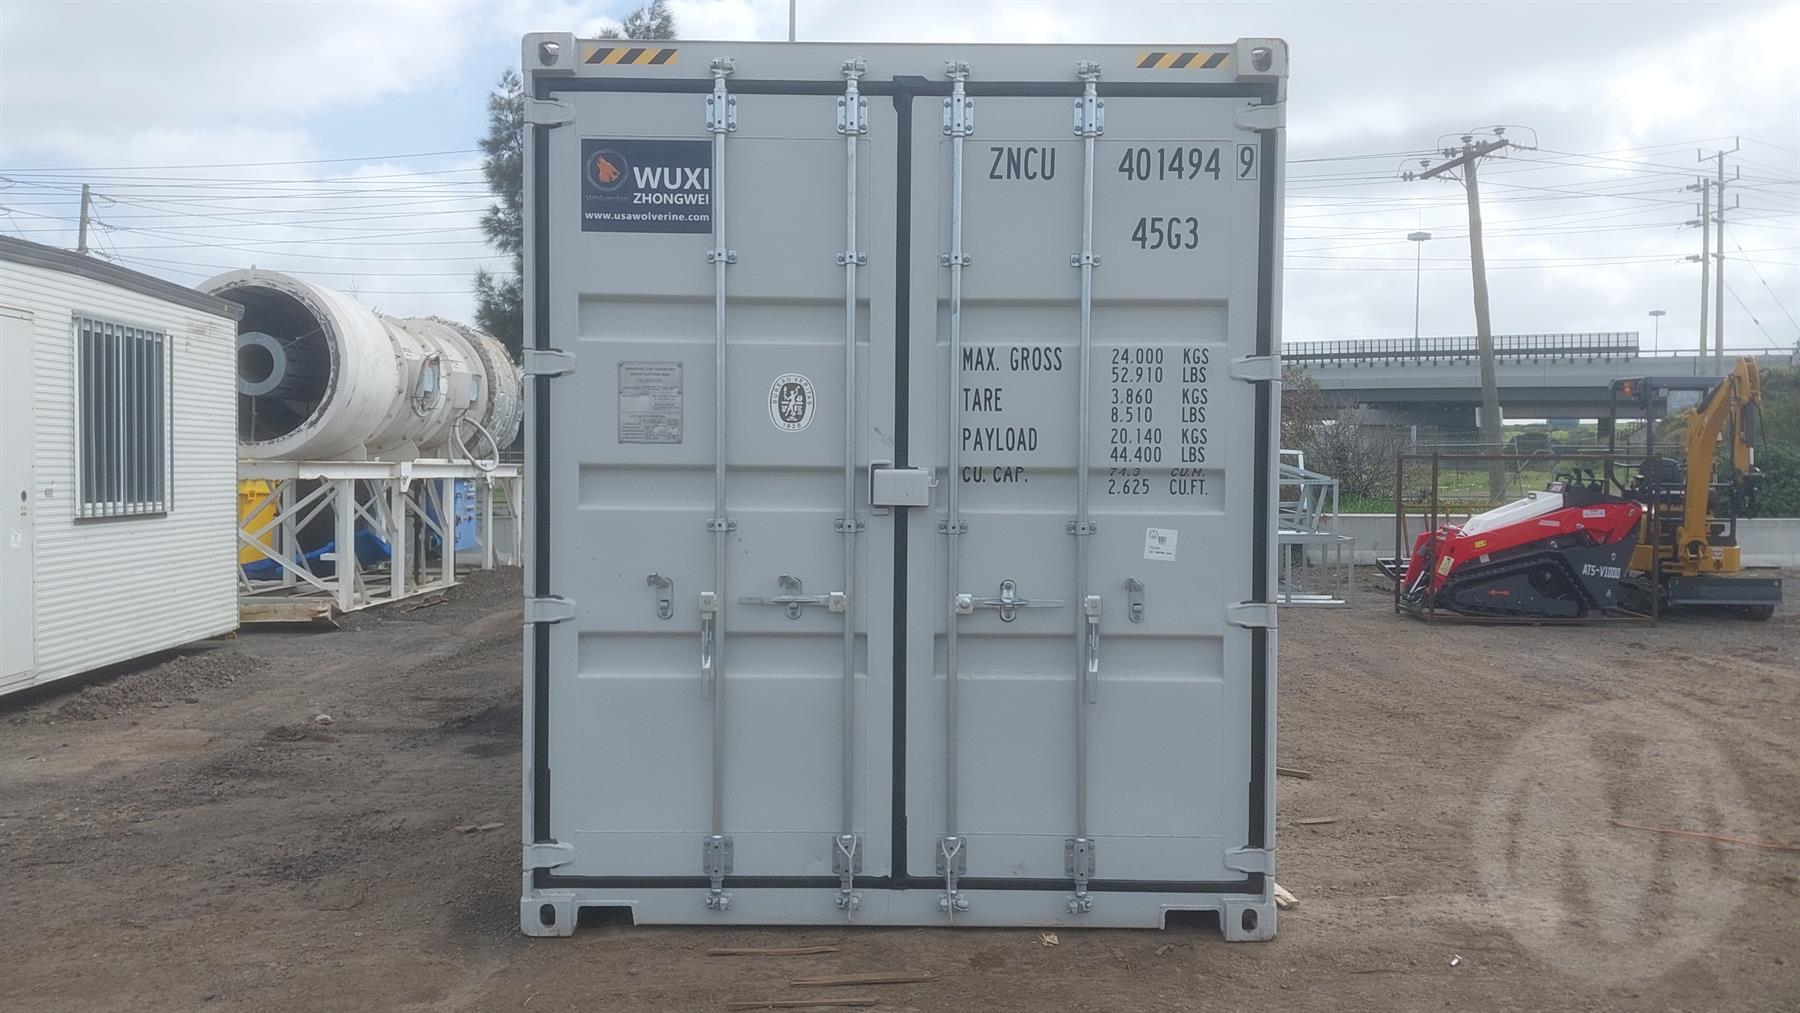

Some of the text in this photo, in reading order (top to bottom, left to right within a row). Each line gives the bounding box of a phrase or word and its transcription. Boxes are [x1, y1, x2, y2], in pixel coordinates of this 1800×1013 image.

[989, 145, 1255, 181] ZNCU 401494 9
[633, 166, 710, 190] WUXI
[632, 192, 709, 205] ZHONGWEI
[584, 211, 710, 222] www.usawolverine.com
[1131, 216, 1199, 250] 45G3
[962, 347, 1000, 371] MAX.
[1010, 346, 1063, 371] GROSS
[1183, 348, 1209, 365] KGS
[1182, 366, 1207, 383] LBS
[962, 388, 1003, 412] TARE
[1182, 387, 1208, 405] KGS
[1181, 406, 1206, 423] LBS
[962, 427, 1038, 452] PAYLOAD
[1181, 427, 1208, 445] KGS
[1181, 446, 1206, 463] LBS
[962, 466, 987, 483] CU.
[993, 466, 1029, 483] CAP.
[1169, 478, 1209, 496] CU.FT.
[1582, 563, 1622, 579] ATS-V1000
